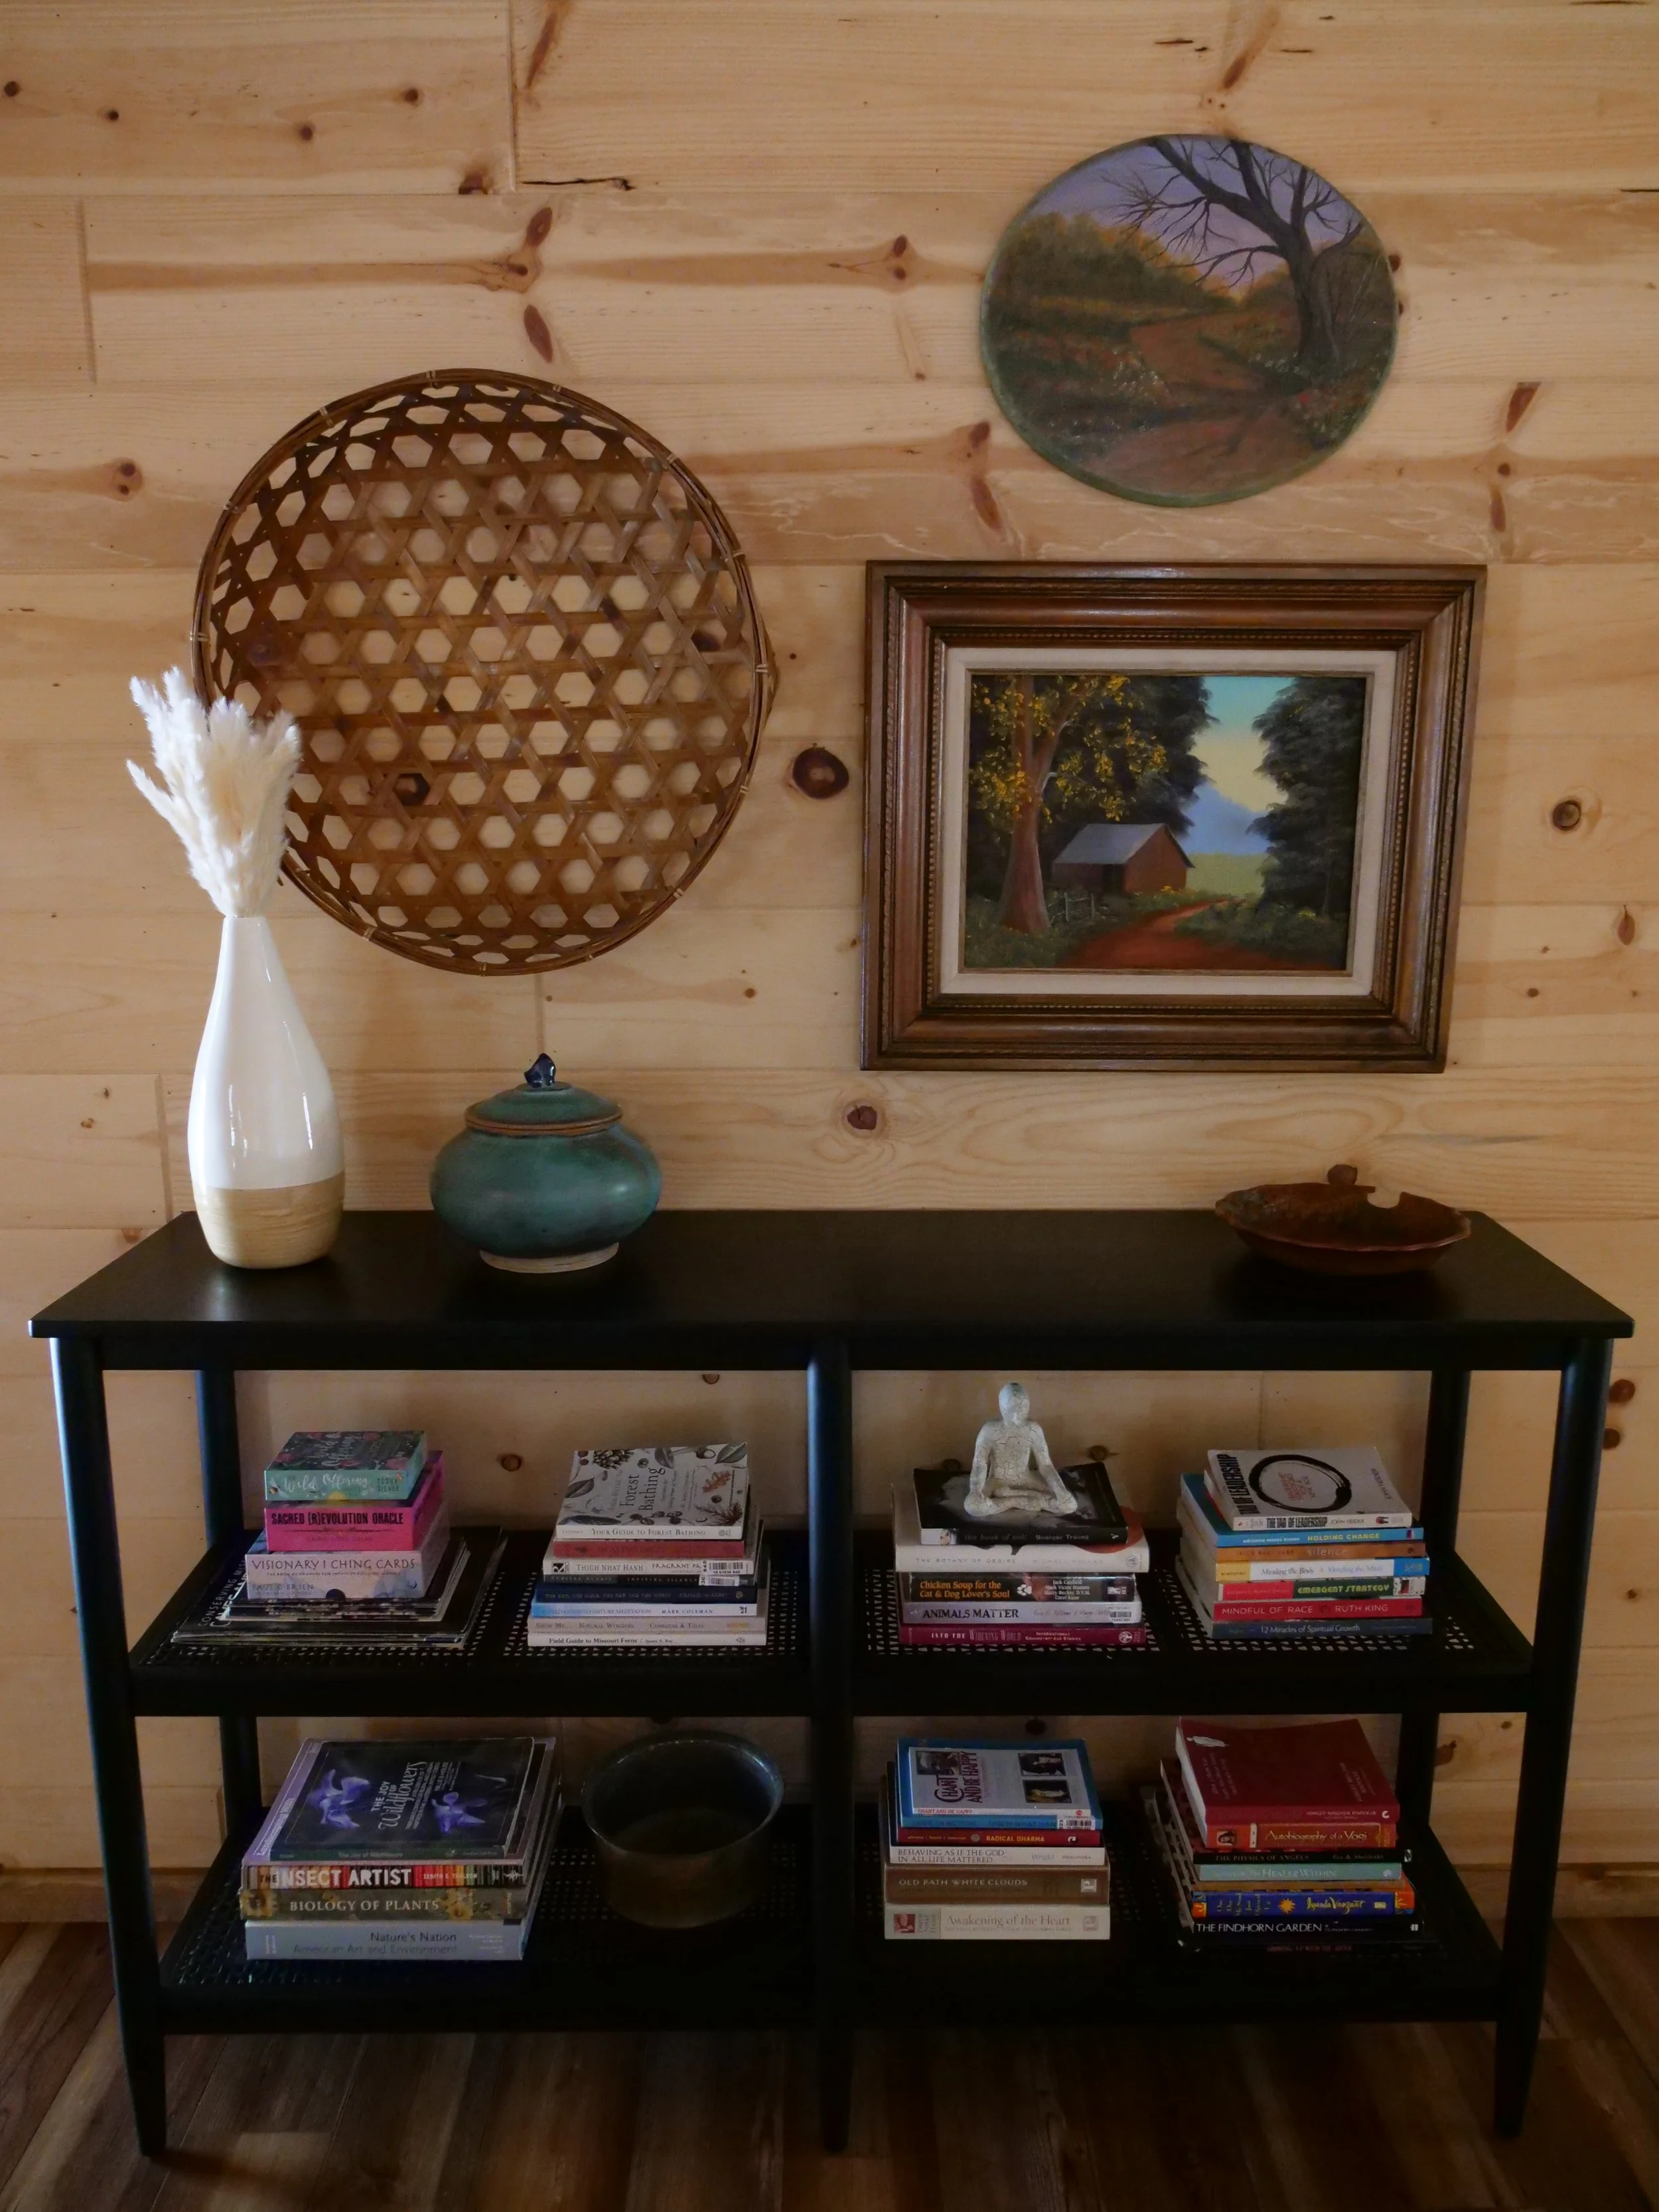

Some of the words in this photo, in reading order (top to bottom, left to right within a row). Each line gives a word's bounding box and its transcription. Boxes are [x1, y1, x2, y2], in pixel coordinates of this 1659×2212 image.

[1216, 1454, 1251, 1496] LEADERSHIP
[619, 1474, 639, 1507] Forest
[638, 1467, 666, 1511] Bathing
[271, 1512, 305, 1525] SACRED
[372, 1512, 404, 1525] ORACLE
[1266, 1517, 1276, 1528] THE
[1277, 1517, 1287, 1528] TAO
[1288, 1517, 1295, 1528] OF
[1295, 1516, 1328, 1528] LEADERSHIP
[1307, 1548, 1348, 1556] silence
[252, 1560, 319, 1570] VISIONARY
[324, 1560, 327, 1569] I
[331, 1560, 372, 1570] CHING
[376, 1558, 415, 1569] CARDS
[952, 1581, 973, 1590] Soup
[944, 1590, 960, 1599] Dog
[922, 1609, 970, 1619] ANIMALS
[973, 1609, 1019, 1618] MATTER
[960, 1751, 979, 1776] HAPPY
[378, 1781, 390, 1795] JOY
[934, 1774, 964, 1803] CHANT
[964, 1786, 983, 1803] AND
[378, 1761, 429, 1829] Wildflowers
[371, 1797, 386, 1811] THE
[1265, 1830, 1328, 1845] Autobiography
[1343, 1830, 1368, 1842] Yogi
[348, 1868, 412, 1886] ARTIST
[290, 1901, 356, 1911] BIOLOGY
[360, 1901, 380, 1911] OF
[386, 1899, 439, 1911] PLANTS
[948, 1915, 1003, 1926] Awakening
[1005, 1915, 1017, 1925] of
[1021, 1915, 1037, 1925] the
[1040, 1915, 1070, 1925] Heart
[1196, 1923, 1216, 1932] THE
[1218, 1923, 1274, 1933] FINDHORN
[1275, 1923, 1322, 1933] GARDEN
[370, 1932, 415, 1942] Nature's
[420, 1932, 457, 1942] Nation
